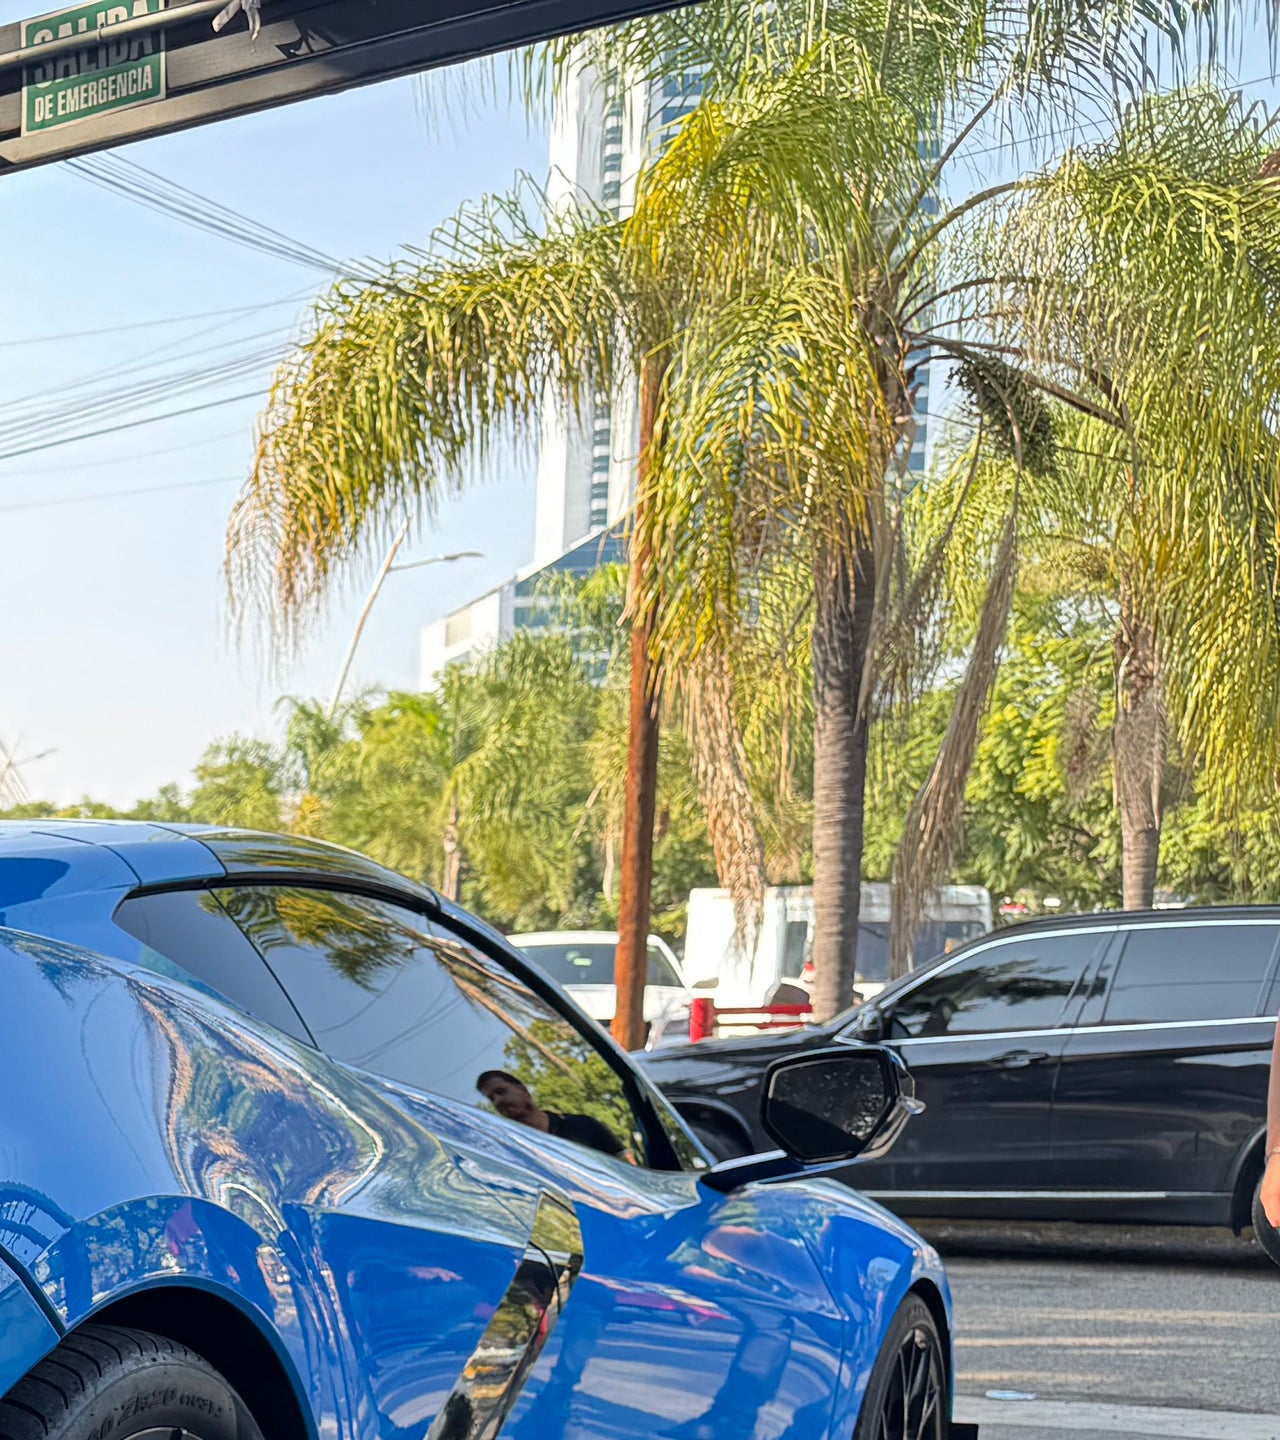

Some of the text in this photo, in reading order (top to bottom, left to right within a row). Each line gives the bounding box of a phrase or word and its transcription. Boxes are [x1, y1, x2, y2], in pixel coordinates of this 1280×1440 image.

[33, 0, 153, 88] SALIDA
[34, 64, 153, 122] DE EMERGENCIA
